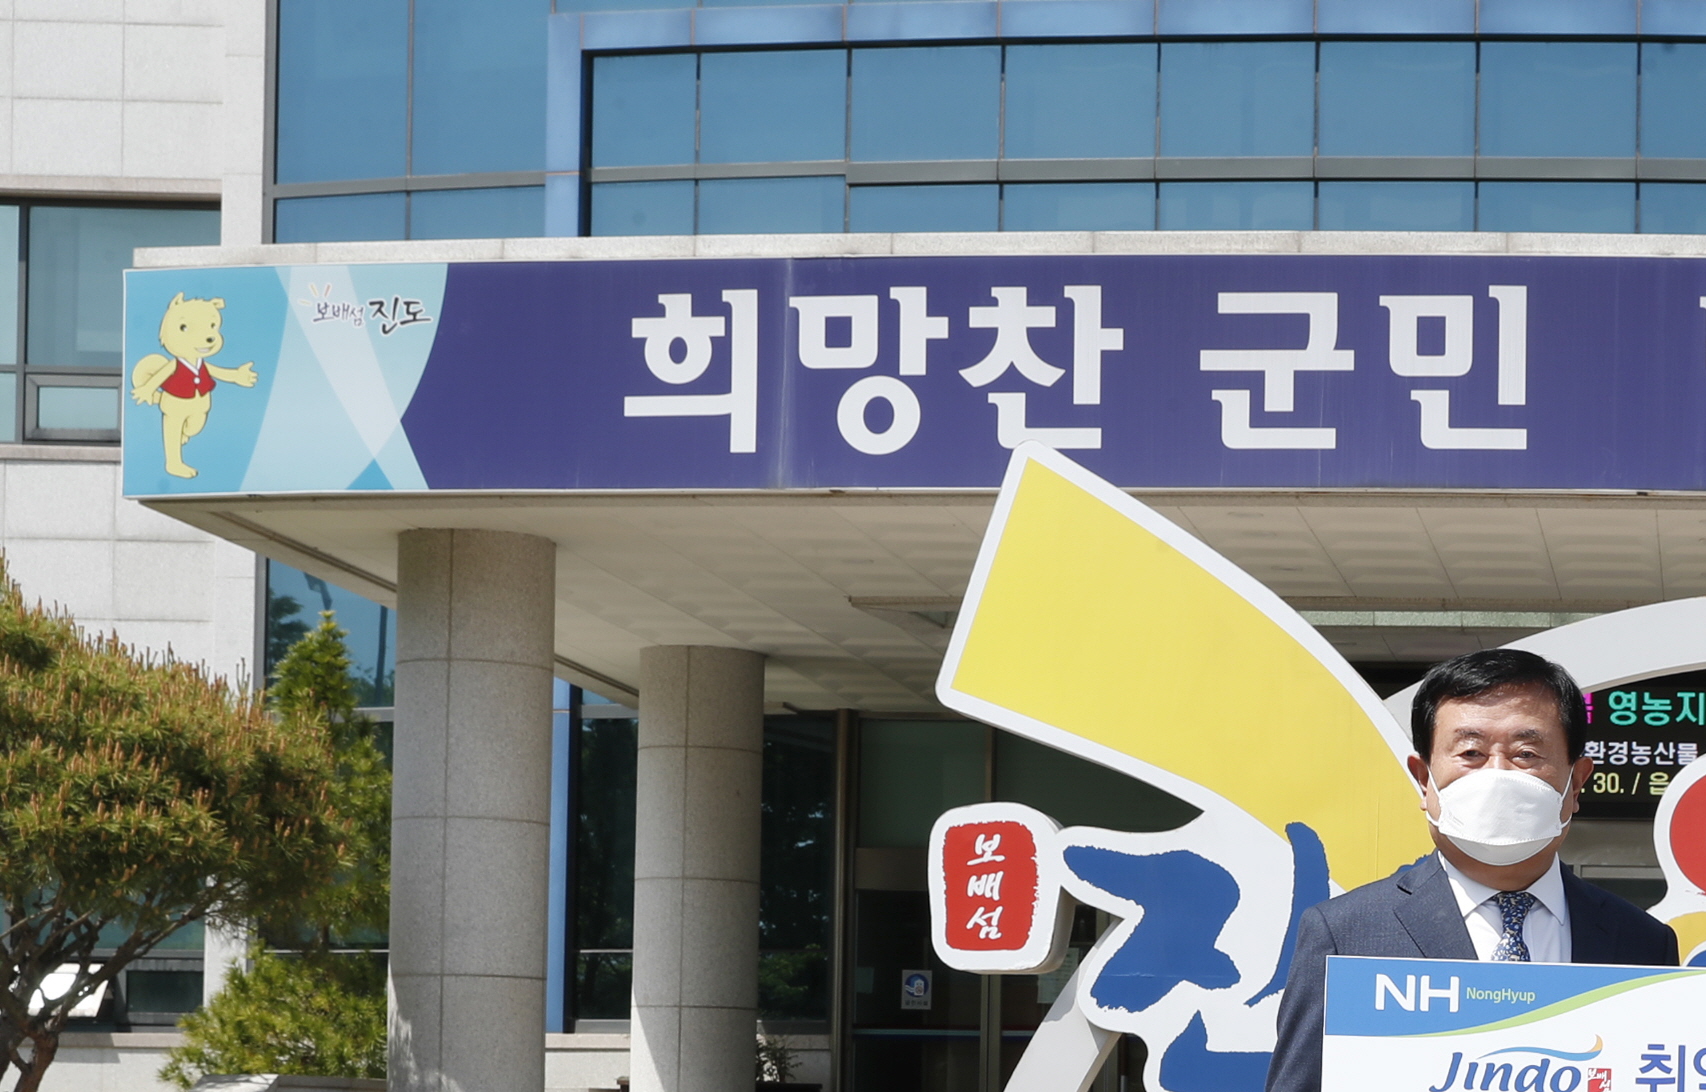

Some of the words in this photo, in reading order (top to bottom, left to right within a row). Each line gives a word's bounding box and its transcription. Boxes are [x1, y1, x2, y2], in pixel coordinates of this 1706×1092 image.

[313, 302, 364, 326] 보배섬
[369, 297, 431, 334] 진도
[624, 285, 1124, 454] 희망찬
[1200, 285, 1527, 450] 군민
[967, 834, 1004, 940] 보배섬
[1375, 974, 1460, 1012] NH
[1466, 987, 1535, 1004] NongHyup
